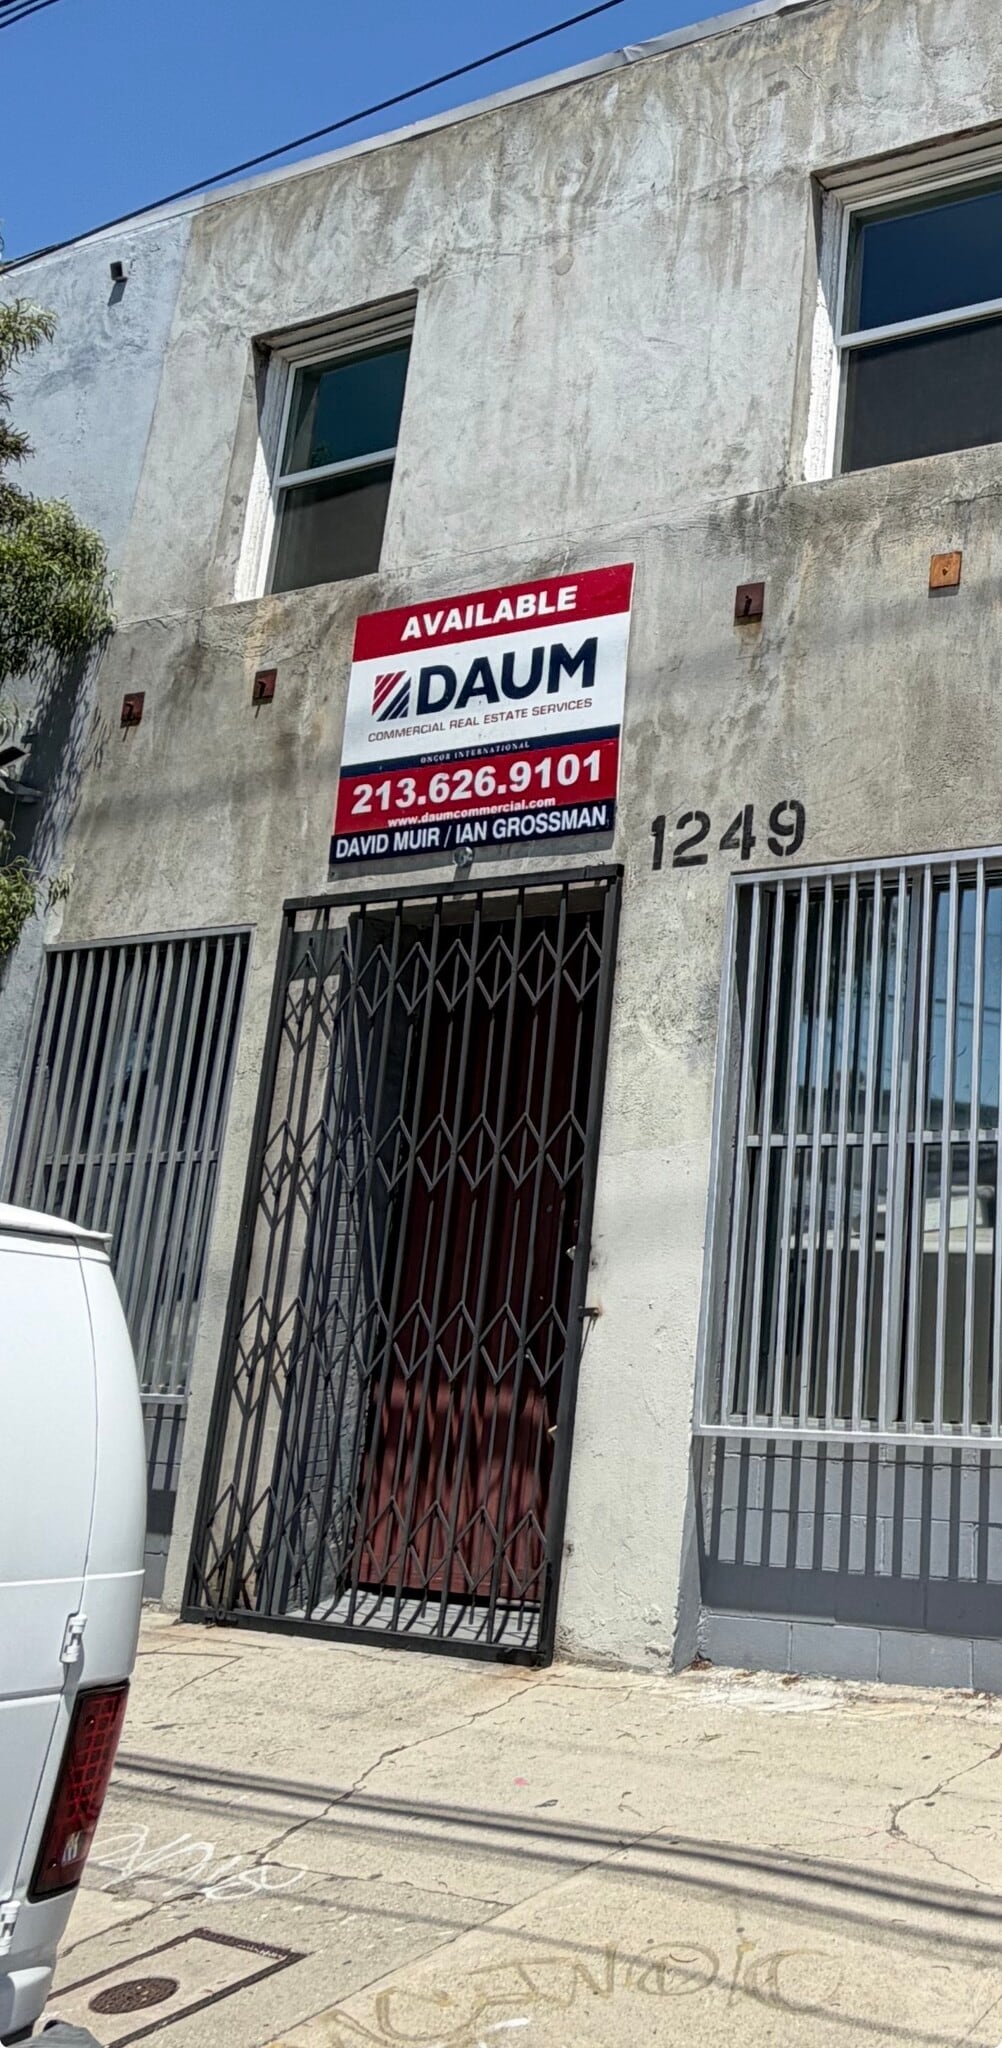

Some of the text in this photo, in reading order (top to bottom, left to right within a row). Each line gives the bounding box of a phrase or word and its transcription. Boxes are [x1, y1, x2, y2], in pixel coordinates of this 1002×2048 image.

[400, 585, 578, 641] AVAILABLE
[415, 636, 599, 716] DAUM
[368, 698, 593, 743] COMMERCIAL REAL ESTATE SERVICES
[420, 741, 530, 764] ONCOR INTERNATIONAL
[350, 750, 601, 815] 213.626.9101
[335, 805, 608, 859] DAVID MUIR / IAN GROSSMAN
[387, 796, 556, 828] www.daumcommercial.com
[651, 800, 806, 871] 1249
